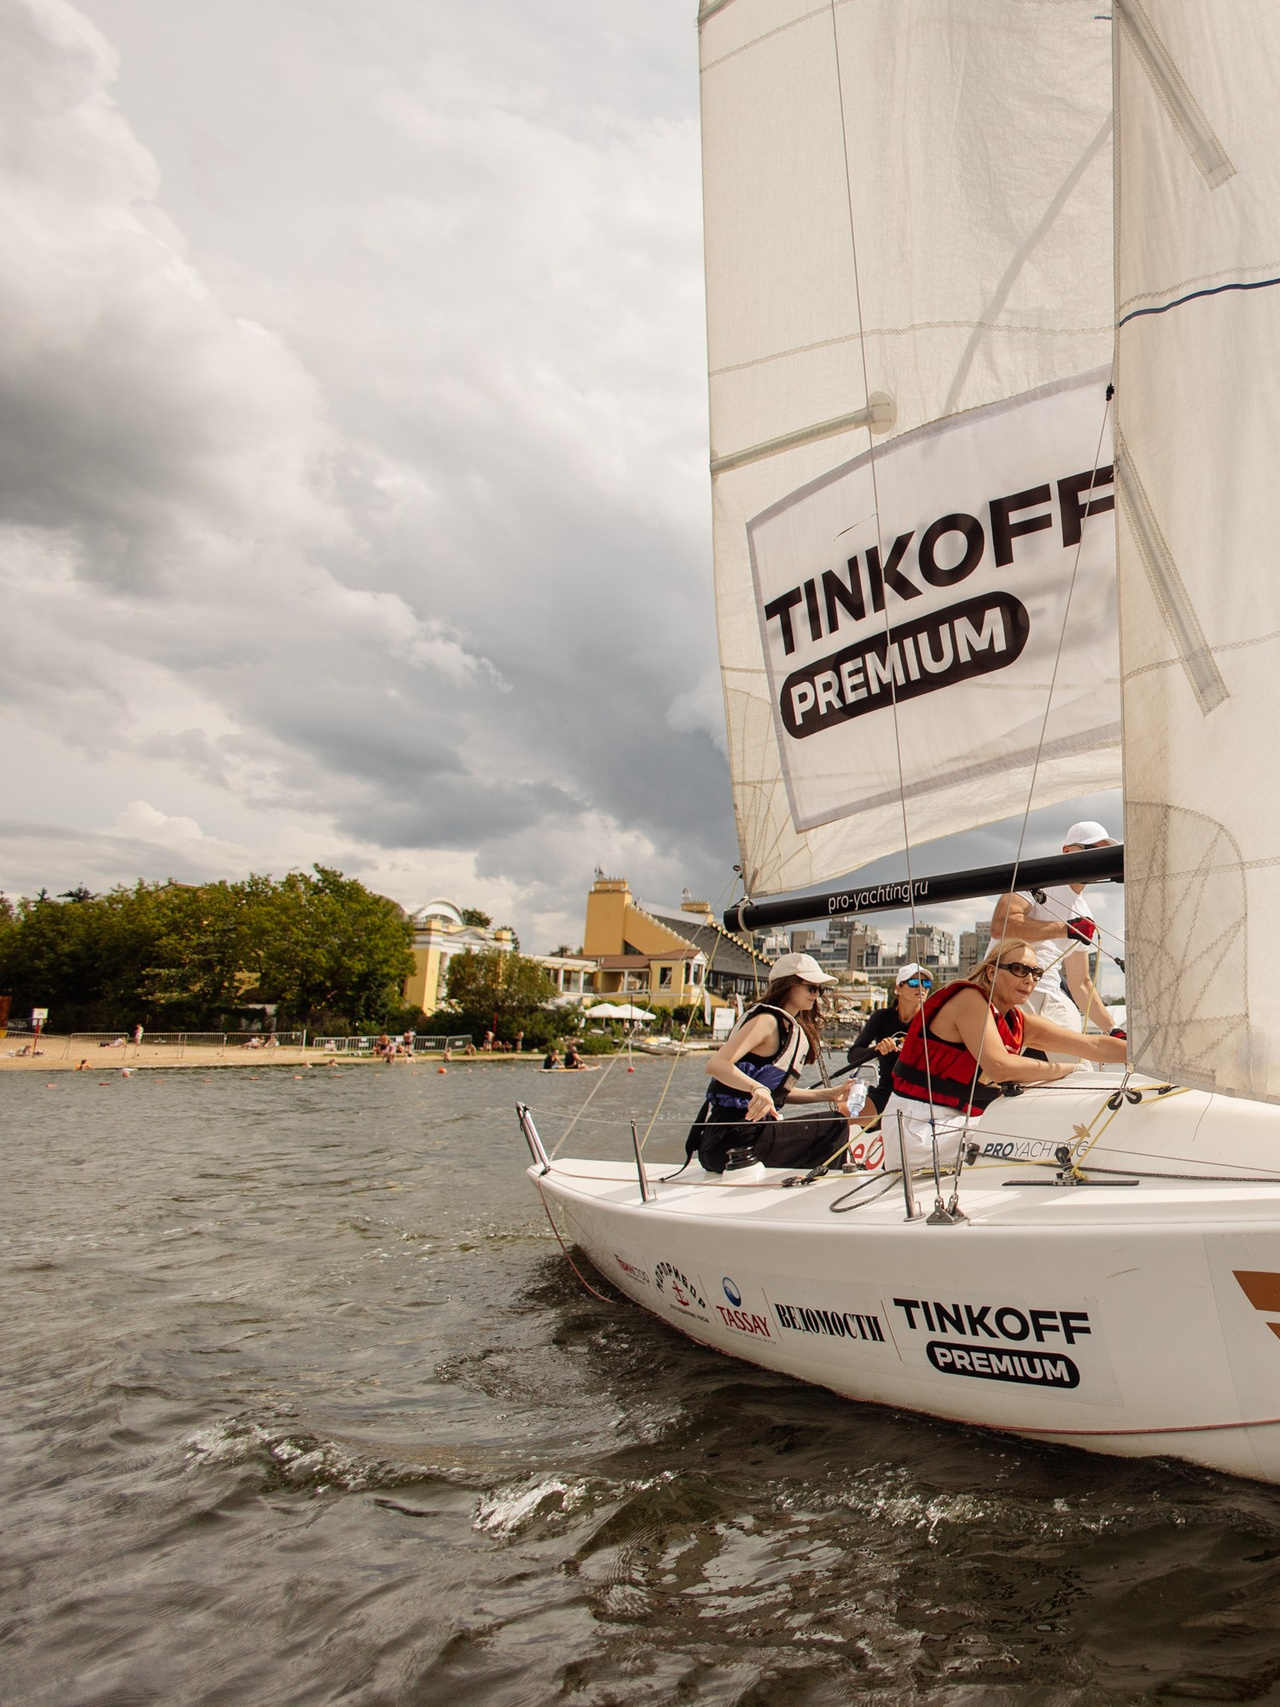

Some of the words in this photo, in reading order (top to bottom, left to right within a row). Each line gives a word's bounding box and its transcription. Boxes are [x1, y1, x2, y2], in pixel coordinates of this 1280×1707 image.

[764, 464, 1115, 656] TINKOFF
[789, 606, 1007, 726] PREMIUM
[828, 880, 929, 914] pro-yachtingru
[716, 1305, 771, 1338] TASSAY
[774, 1303, 886, 1342] ВЕДОМОСТИ
[893, 1297, 1092, 1345] TINKOFF
[933, 1347, 1071, 1382] PREMIUM
